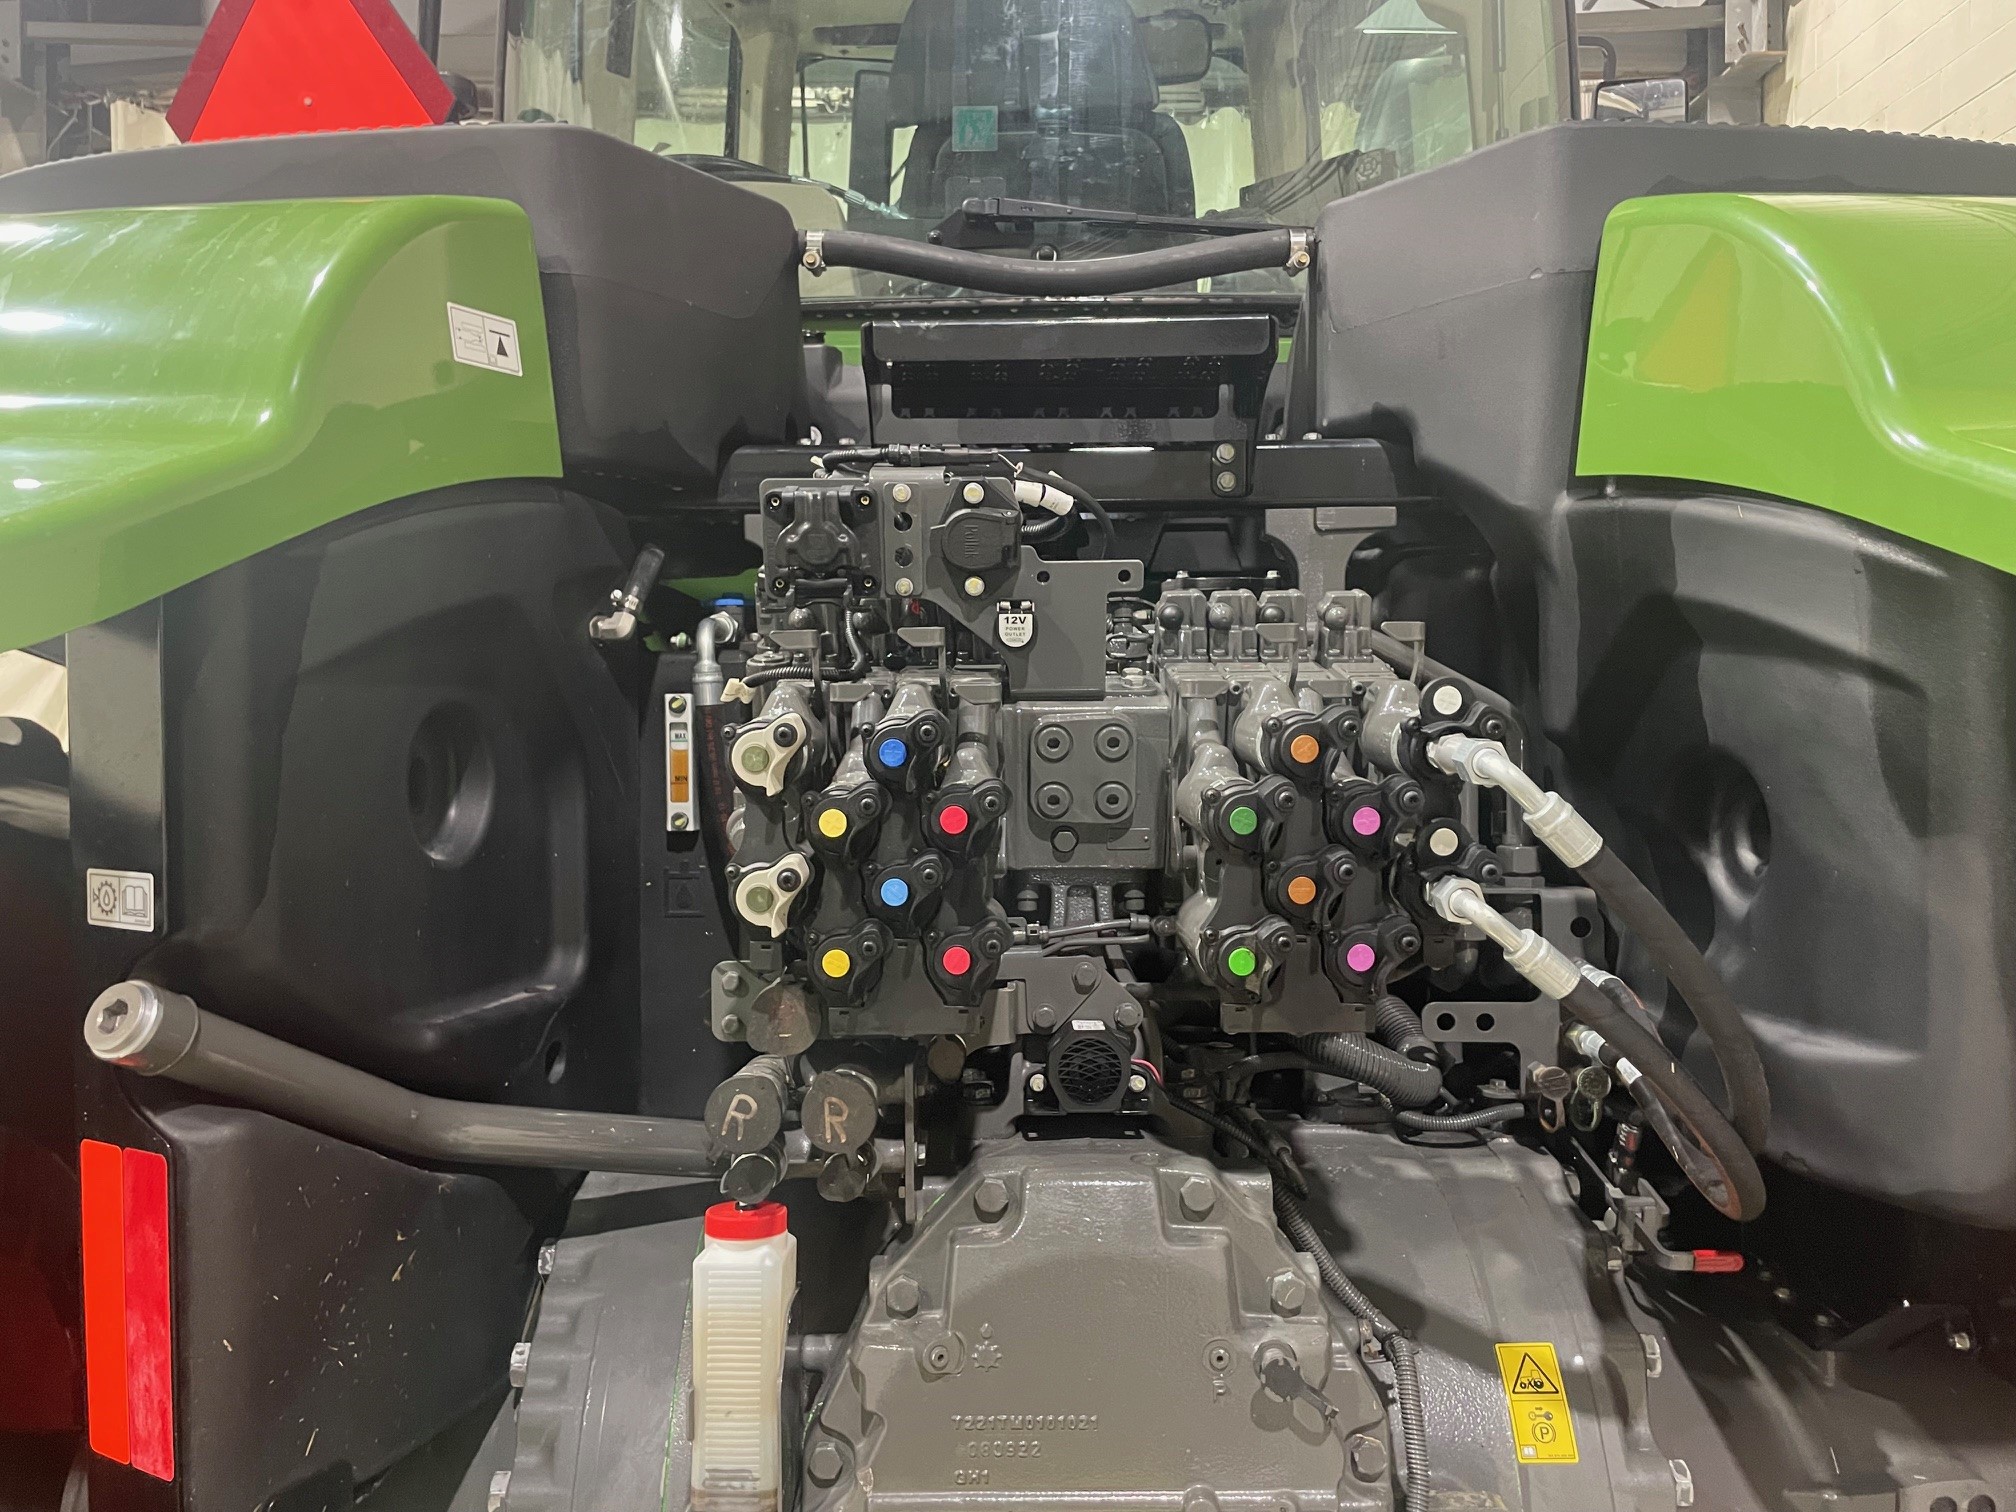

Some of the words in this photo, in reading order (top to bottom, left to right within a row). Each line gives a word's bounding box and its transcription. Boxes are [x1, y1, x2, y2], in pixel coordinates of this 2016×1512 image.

[964, 524, 979, 559] Pollak
[1004, 616, 1026, 624] 12V
[721, 1093, 758, 1141] R
[824, 1096, 849, 1143] R
[1540, 1427, 1549, 1440] P
